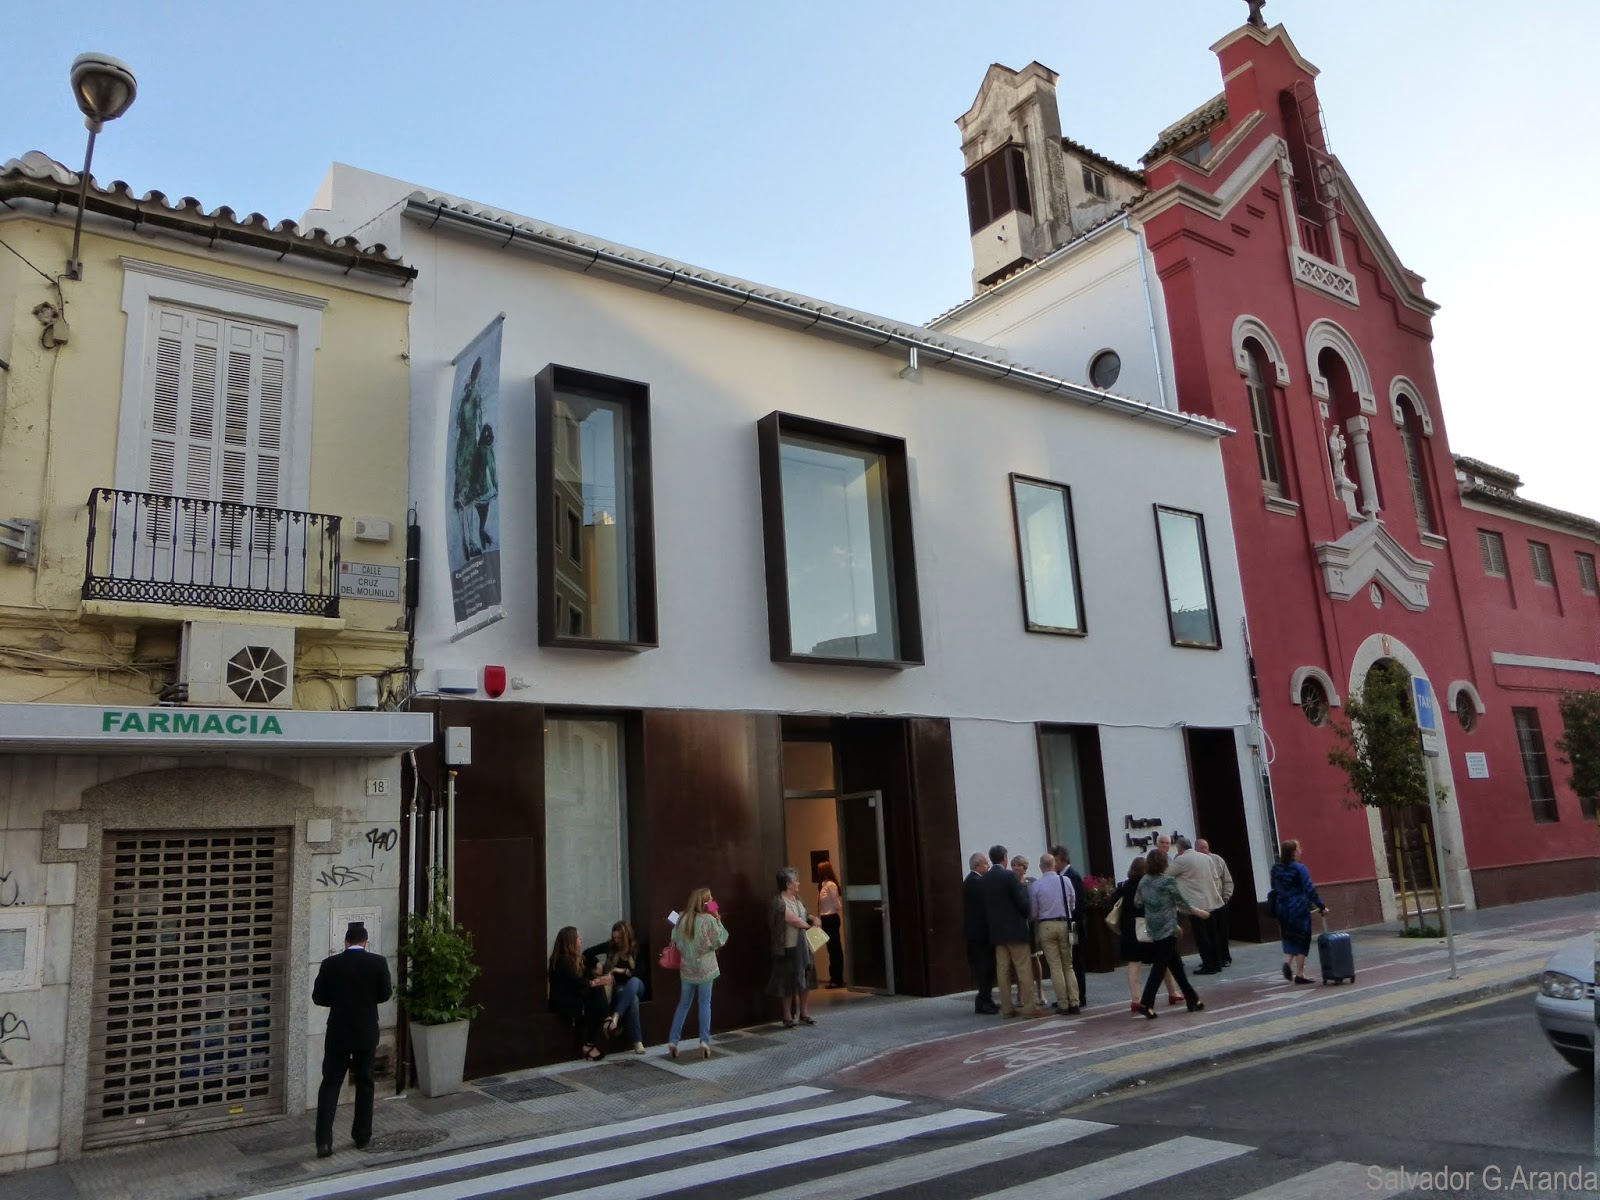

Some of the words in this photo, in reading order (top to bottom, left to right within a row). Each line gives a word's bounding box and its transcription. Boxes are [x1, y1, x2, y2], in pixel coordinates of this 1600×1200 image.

[362, 566, 382, 575] CALLE
[358, 578, 379, 587] CRUZ
[341, 586, 355, 594] DEL
[357, 588, 395, 598] MOLINILLO
[102, 711, 283, 735] FARMACIA
[372, 781, 384, 793] 18
